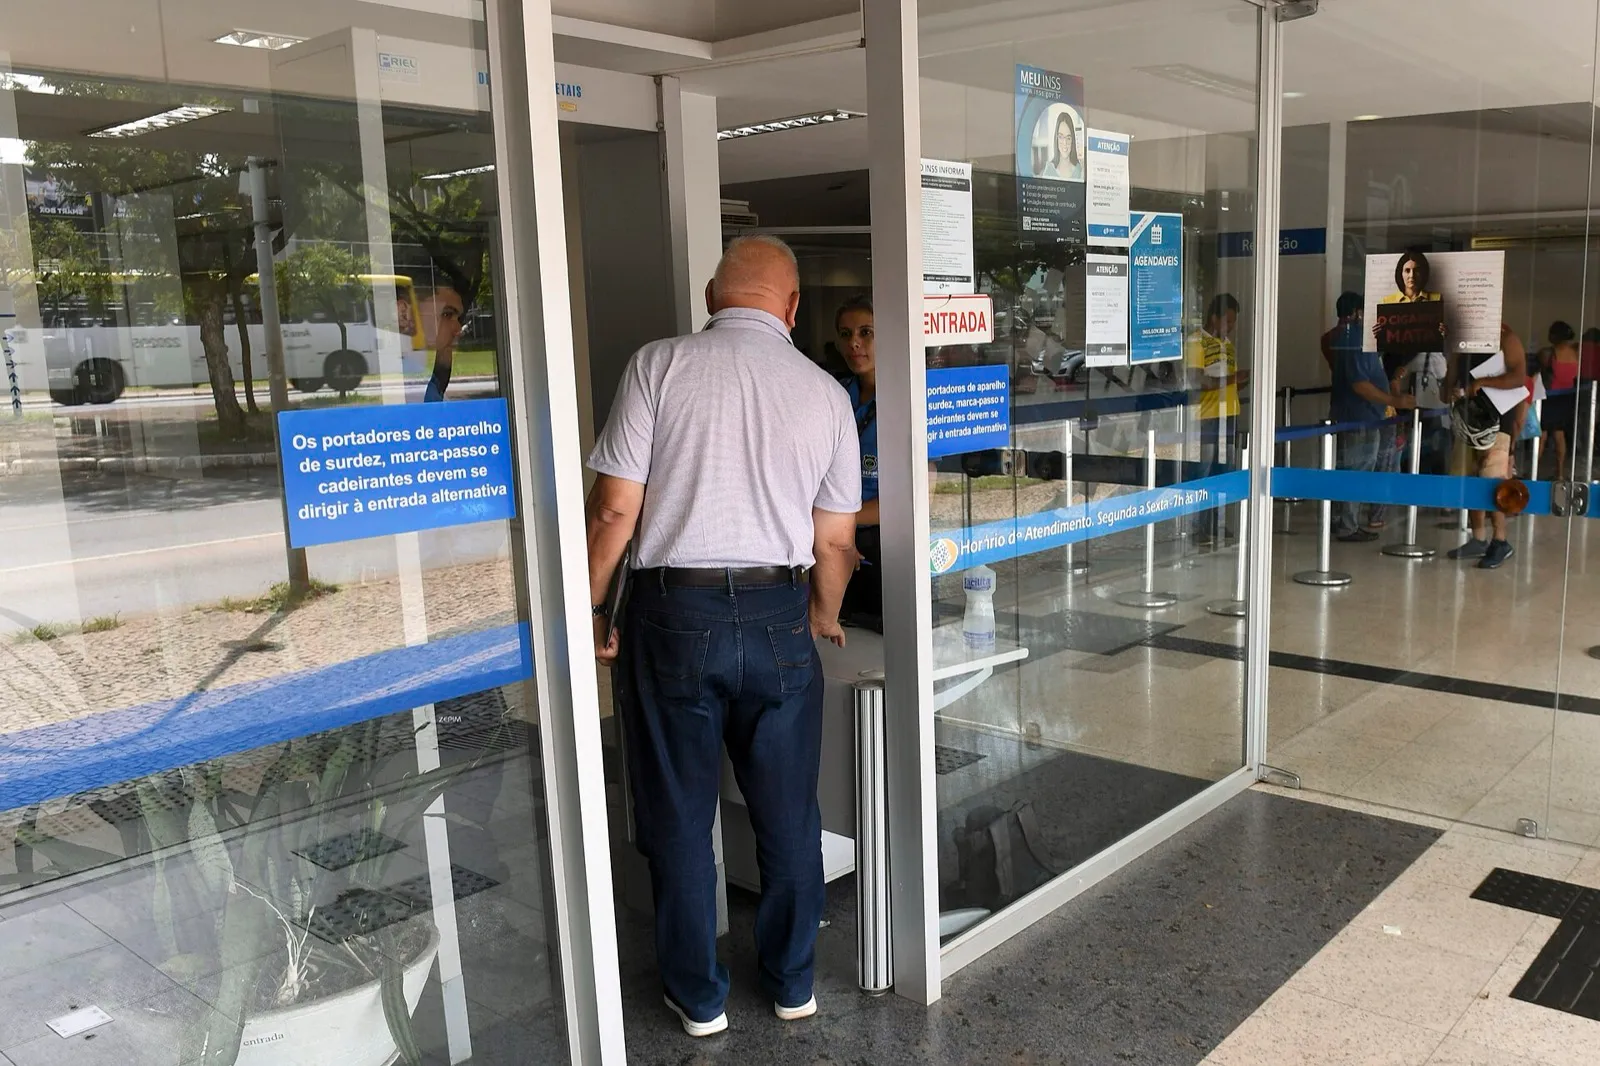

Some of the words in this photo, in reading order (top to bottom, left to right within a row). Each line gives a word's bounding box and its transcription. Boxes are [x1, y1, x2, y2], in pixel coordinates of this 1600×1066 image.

[1020, 70, 1040, 86] MEU
[1042, 74, 1061, 90] INSS
[556, 82, 582, 98] ETAIS
[1097, 142, 1120, 152] ATENÇÃO
[925, 164, 938, 174] INSS
[939, 166, 965, 176] INFORMA
[1096, 264, 1118, 275] ATENÇÃO
[924, 312, 987, 334] ENTRADA
[928, 384, 965, 398] portadores
[967, 382, 976, 392] de
[977, 380, 1006, 392] aparelho
[928, 400, 954, 411] surdez,
[956, 397, 999, 408] marca-passo
[967, 412, 989, 421] devem
[292, 435, 317, 450] Os
[322, 429, 410, 451] portadores
[415, 426, 434, 439] de
[438, 421, 501, 440] aparelho
[939, 429, 944, 439] à
[945, 426, 971, 438] entrada
[972, 422, 1007, 435] alternativa
[299, 458, 320, 473] de
[325, 452, 386, 471] surdez,
[390, 446, 487, 464] marca-passo
[491, 444, 499, 454] e
[318, 472, 413, 494] cadeirantes
[417, 467, 466, 483] devem
[471, 465, 488, 477] se
[298, 501, 349, 520] dirigir
[353, 497, 364, 513] à
[368, 492, 427, 511] entrada
[431, 483, 507, 504] alternativa
[1024, 517, 1094, 541] Atendimento.
[1097, 505, 1137, 526] Segunda
[1185, 494, 1193, 504] às
[1196, 489, 1208, 502] 17h
[243, 1033, 284, 1046] entrada
